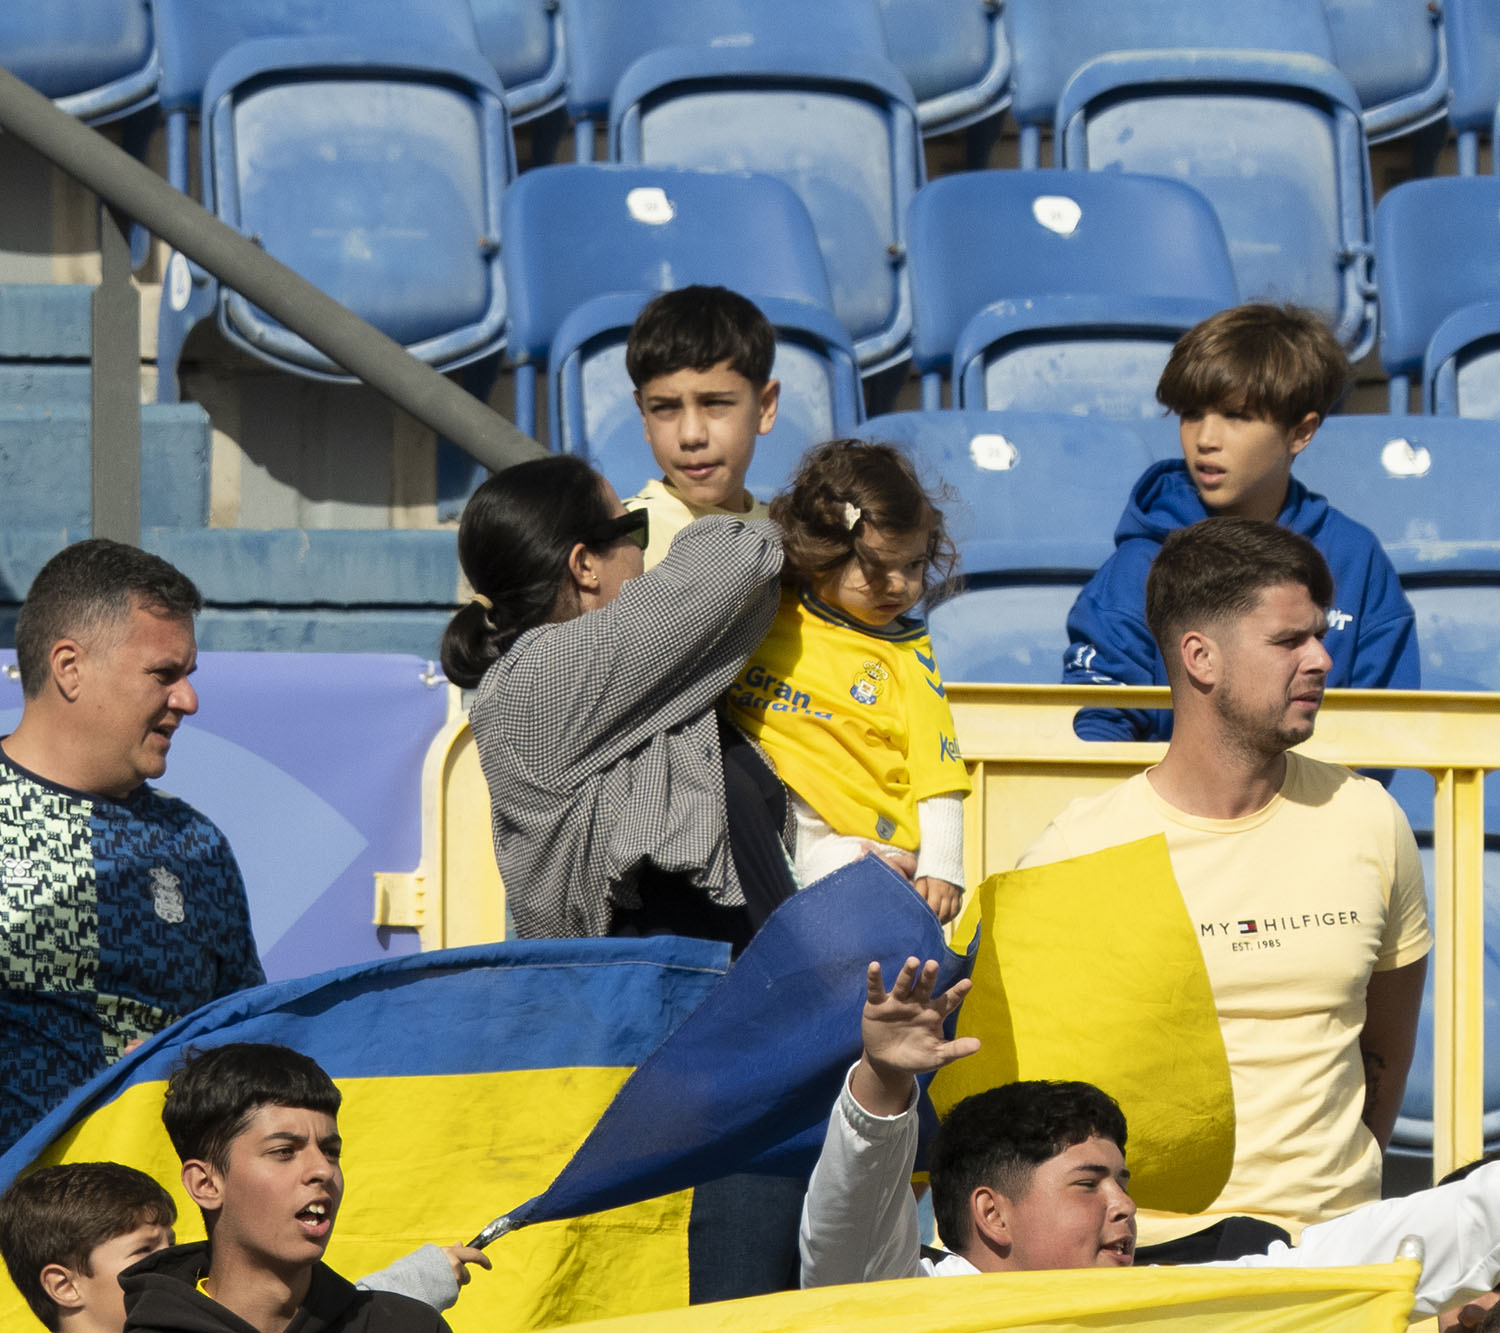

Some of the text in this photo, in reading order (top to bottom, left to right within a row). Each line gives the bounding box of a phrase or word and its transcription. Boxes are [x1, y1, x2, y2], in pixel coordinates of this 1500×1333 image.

[744, 664, 812, 711] Gran
[1262, 909, 1362, 934] HILFIGER
[1231, 938, 1282, 954] EST. 1985
